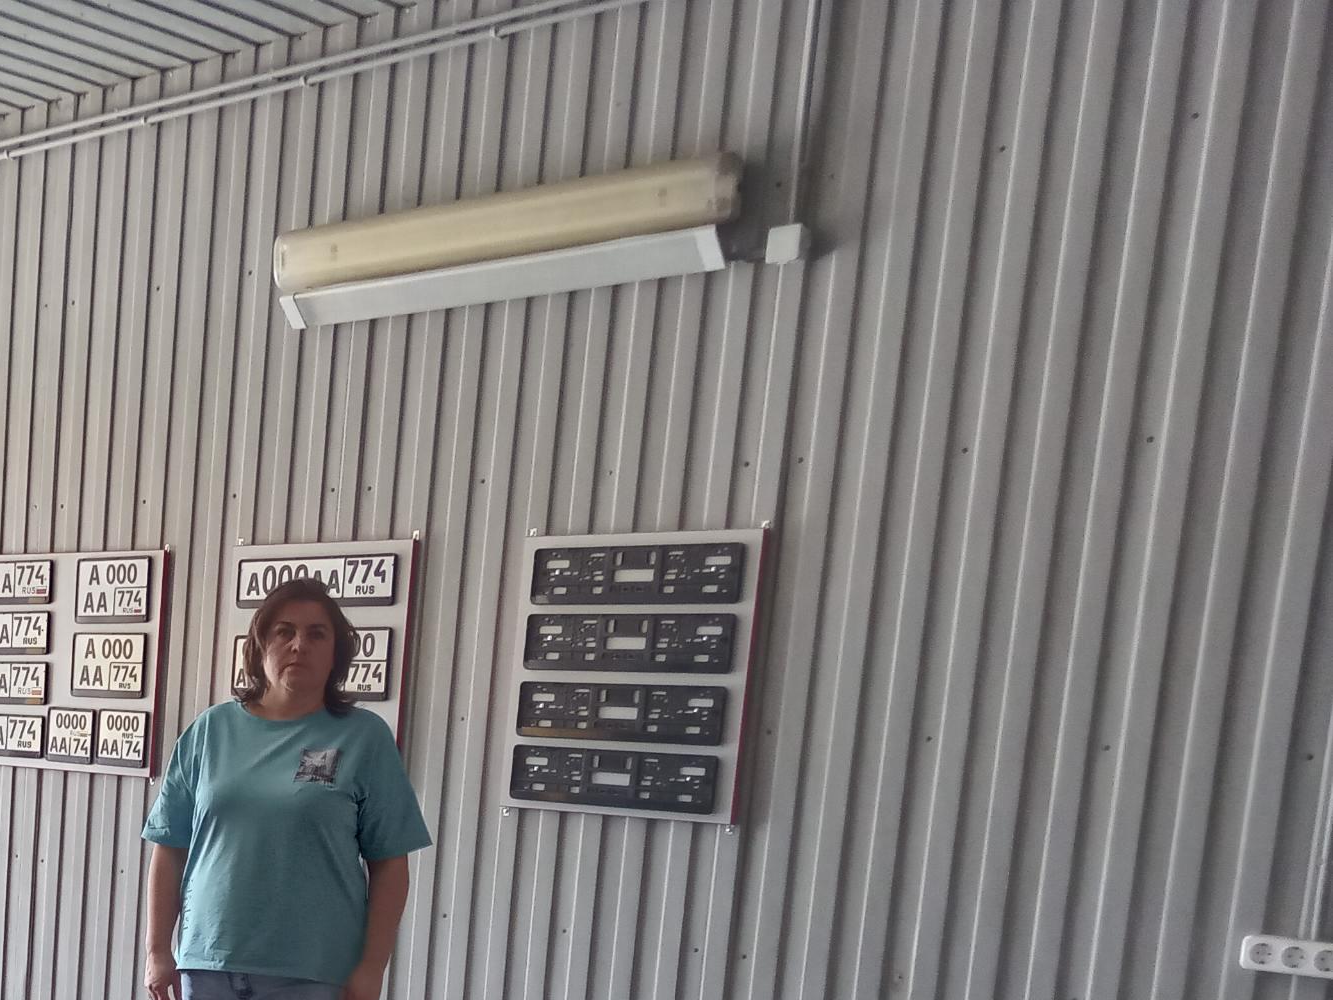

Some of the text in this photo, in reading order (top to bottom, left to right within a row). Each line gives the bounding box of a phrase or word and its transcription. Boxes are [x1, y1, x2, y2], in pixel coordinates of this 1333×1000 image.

[16, 565, 44, 586] 774
[106, 563, 138, 585] 000
[347, 559, 385, 584] 774
[22, 587, 36, 595] RUS
[117, 590, 142, 607] 774
[355, 585, 375, 595] RUS
[14, 616, 41, 636] 774
[23, 637, 38, 645] RUS
[102, 638, 134, 660] 000
[12, 666, 39, 687] 774
[113, 665, 138, 683] 774
[349, 663, 382, 684] 774
[119, 682, 131, 690] RUS
[356, 683, 372, 692] RUS
[9, 719, 36, 741] 774
[56, 712, 87, 730] 0000
[107, 714, 139, 732] 0000
[17, 740, 32, 748] RUS
[73, 738, 88, 755] 74
[125, 740, 140, 758] 74
